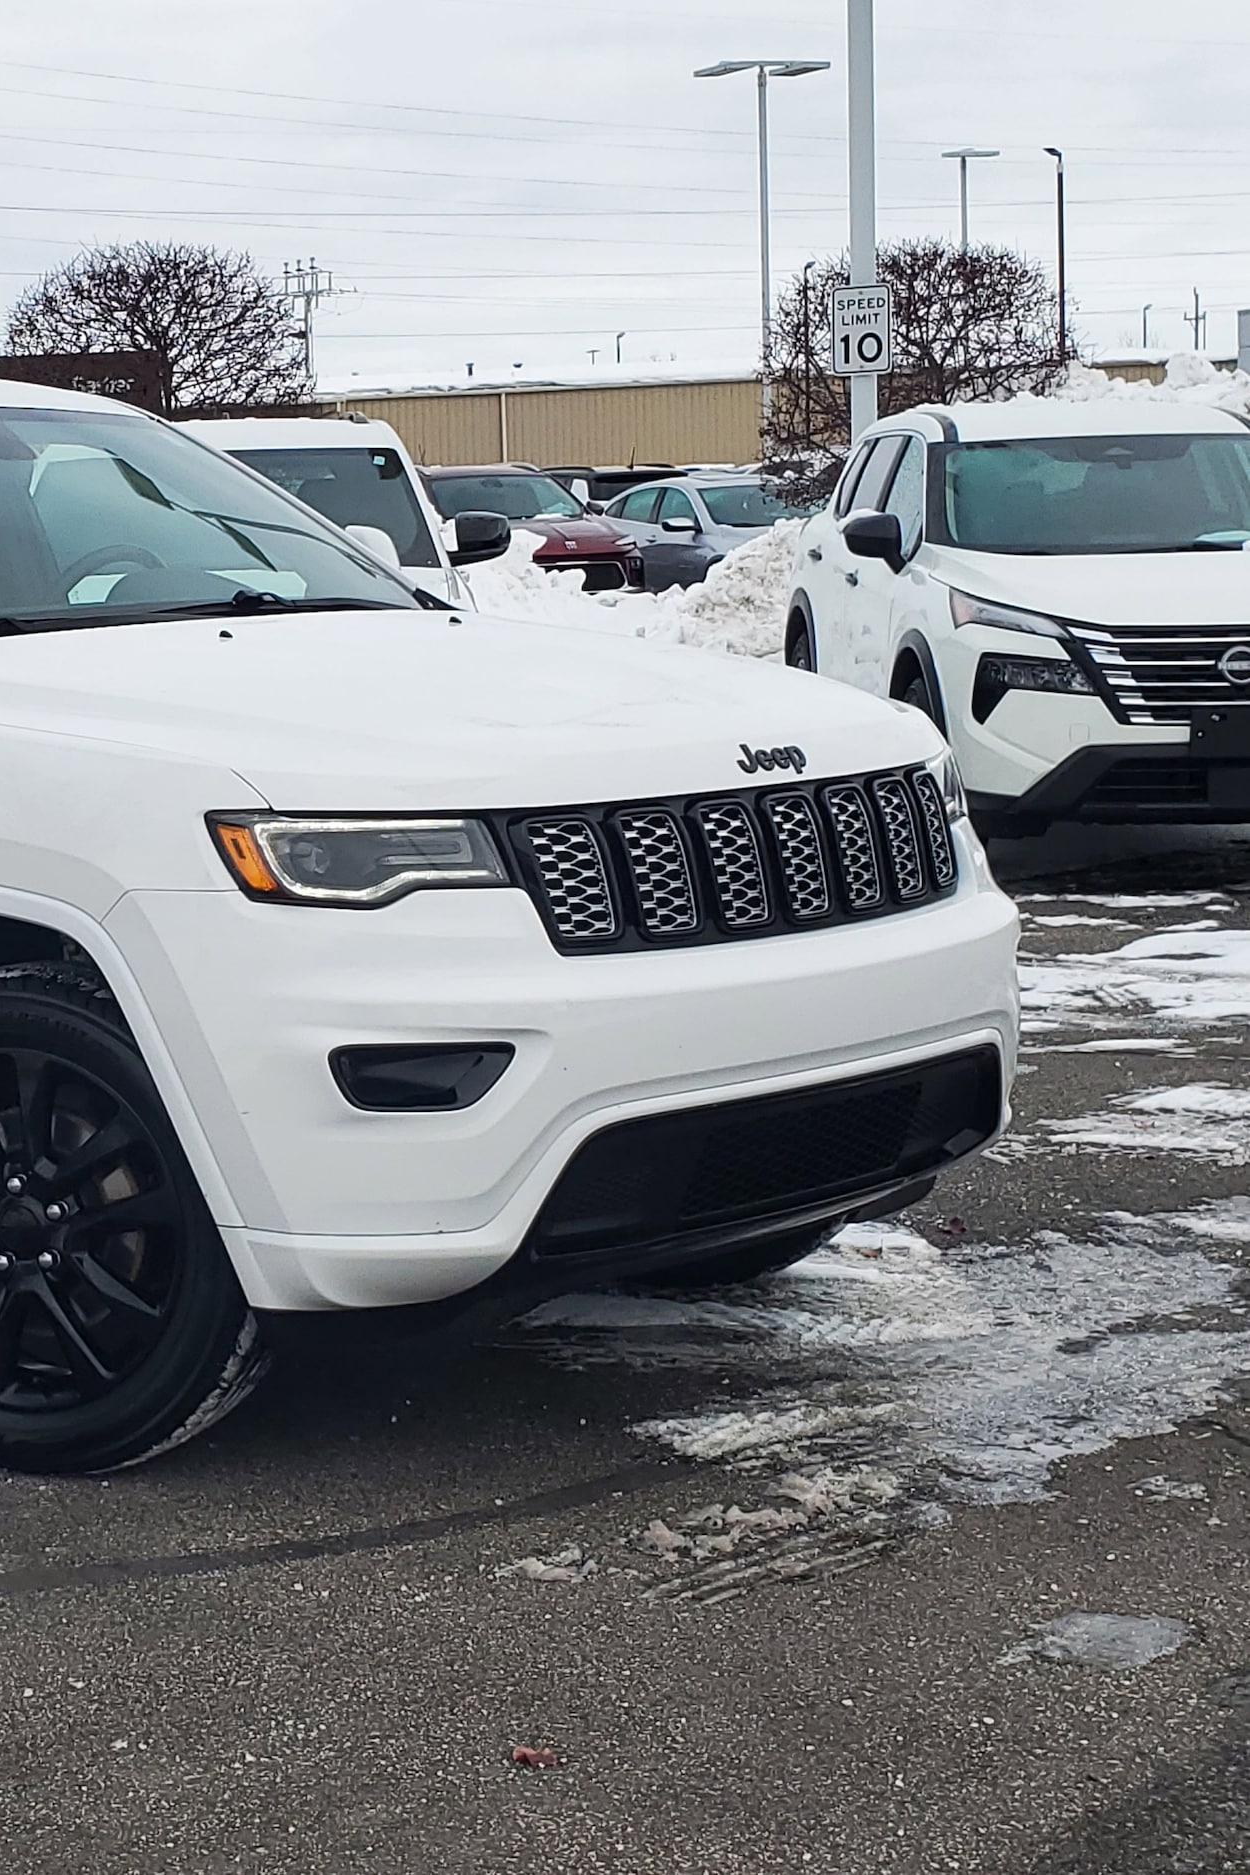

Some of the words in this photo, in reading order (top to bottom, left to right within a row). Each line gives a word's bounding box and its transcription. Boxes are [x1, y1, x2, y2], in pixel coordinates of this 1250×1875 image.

[837, 297, 886, 311] SPEED
[842, 313, 881, 326] LIMIT
[840, 332, 883, 364] 10
[736, 743, 806, 775] Jeep
